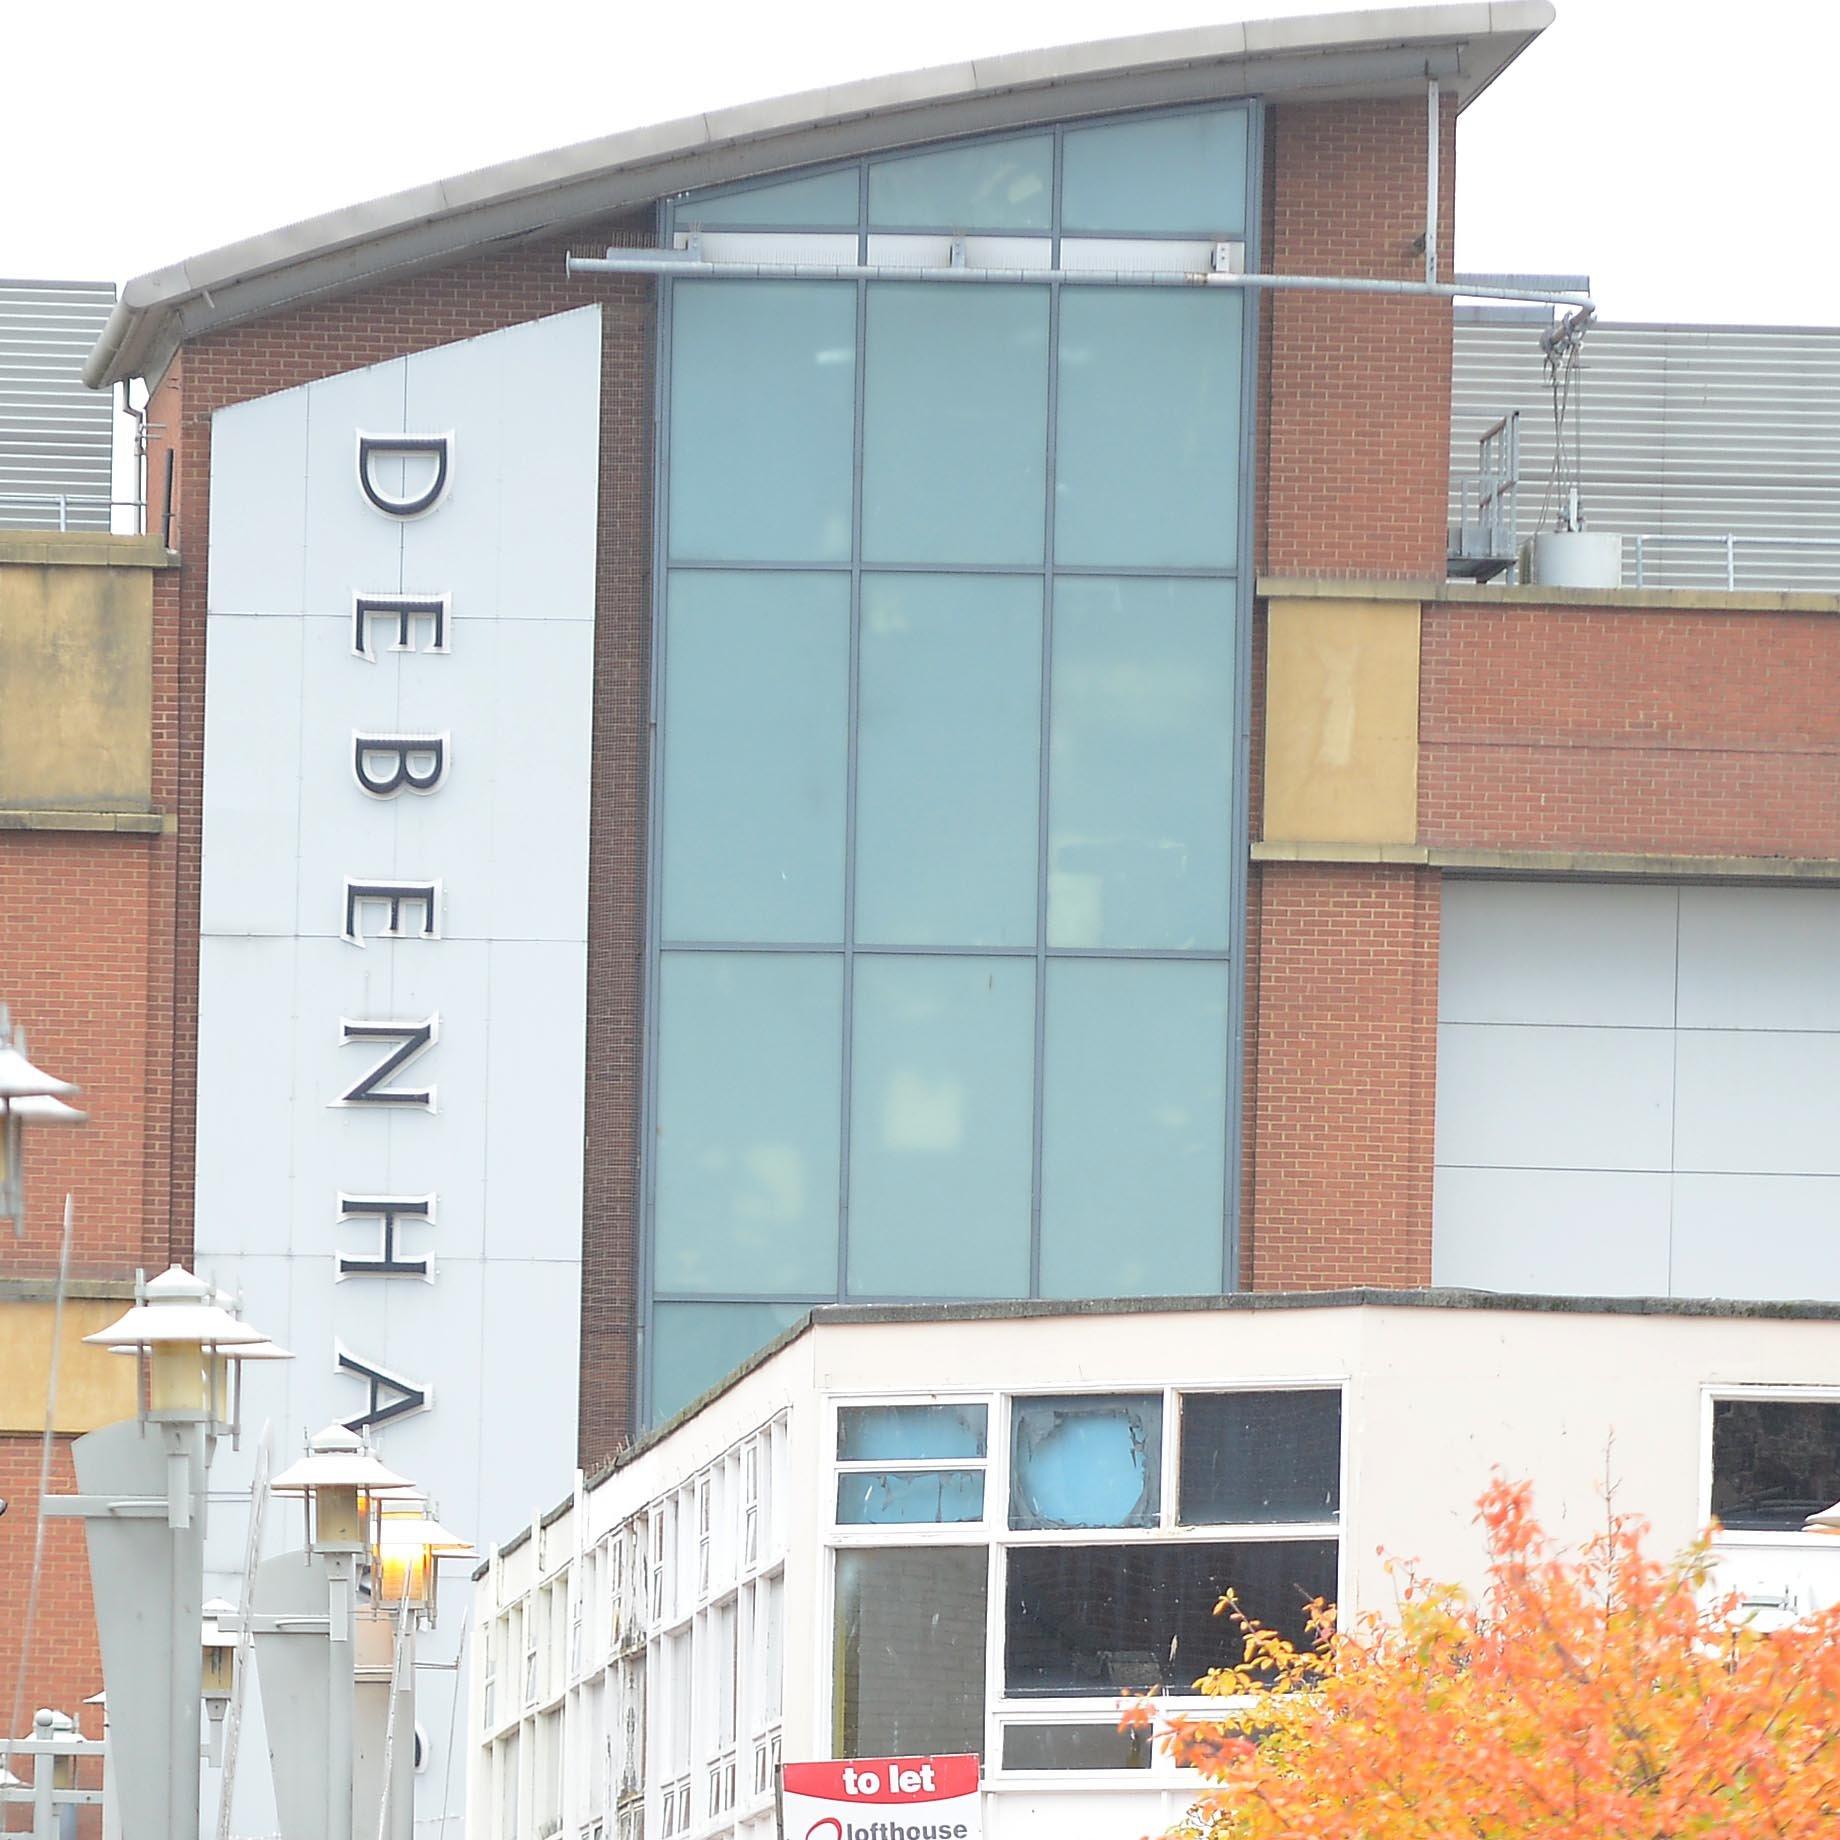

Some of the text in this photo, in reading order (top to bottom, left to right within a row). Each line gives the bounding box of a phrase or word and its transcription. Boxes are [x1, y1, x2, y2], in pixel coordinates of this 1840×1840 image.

[325, 427, 457, 1437] DEBENHA
[842, 1763, 936, 1796] to let
